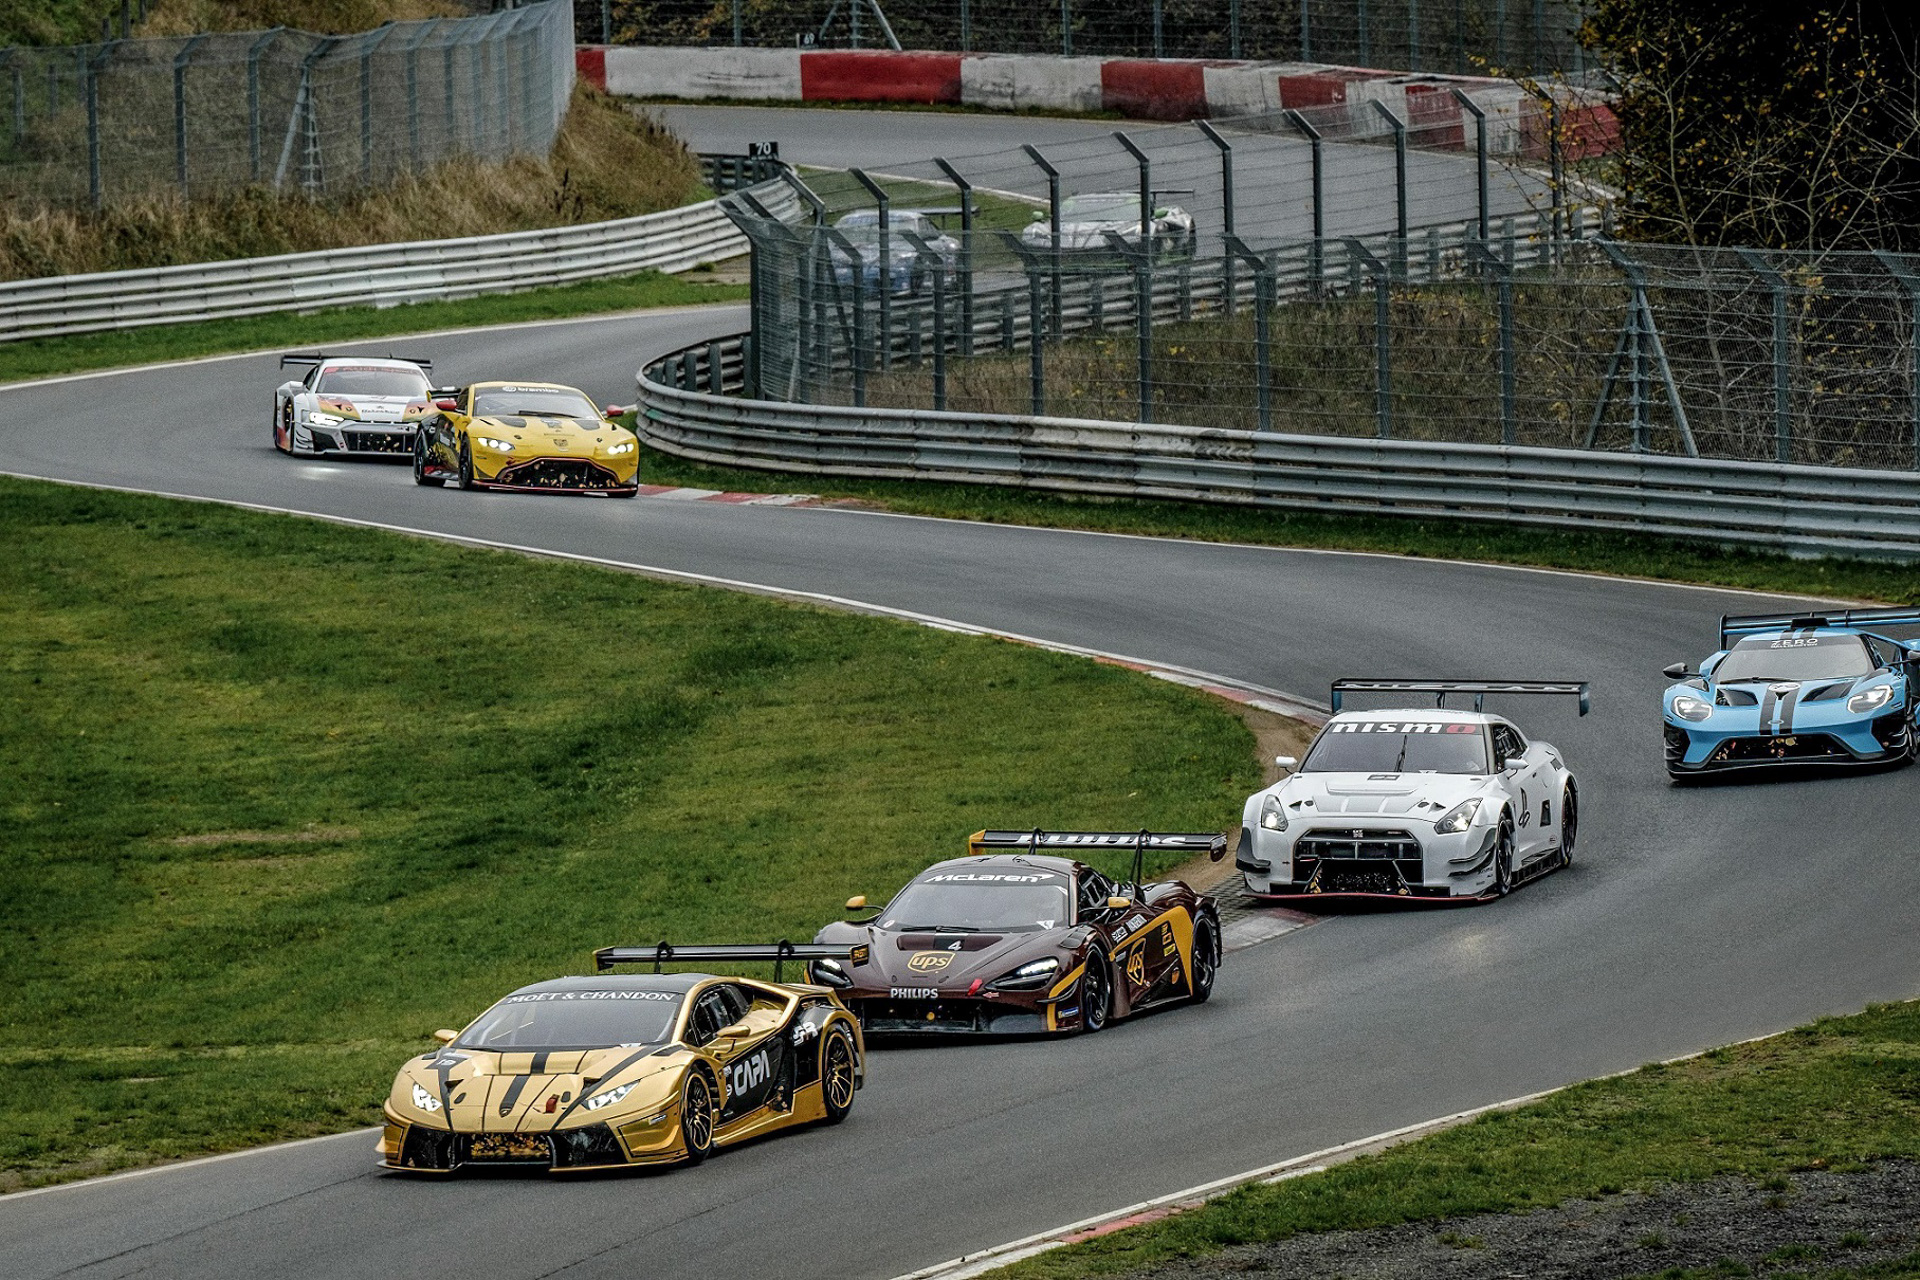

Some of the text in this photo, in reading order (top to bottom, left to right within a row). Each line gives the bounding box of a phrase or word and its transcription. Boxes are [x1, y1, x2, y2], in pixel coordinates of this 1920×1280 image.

[803, 33, 815, 44] 69
[756, 142, 771, 155] 70
[1332, 723, 1476, 734] nismo
[924, 874, 1056, 883] McLaren
[948, 940, 962, 951] 4
[911, 956, 949, 970] ups
[562, 992, 576, 1000] &
[580, 991, 677, 1001] CHANDON
[890, 988, 939, 999] PHILIPS
